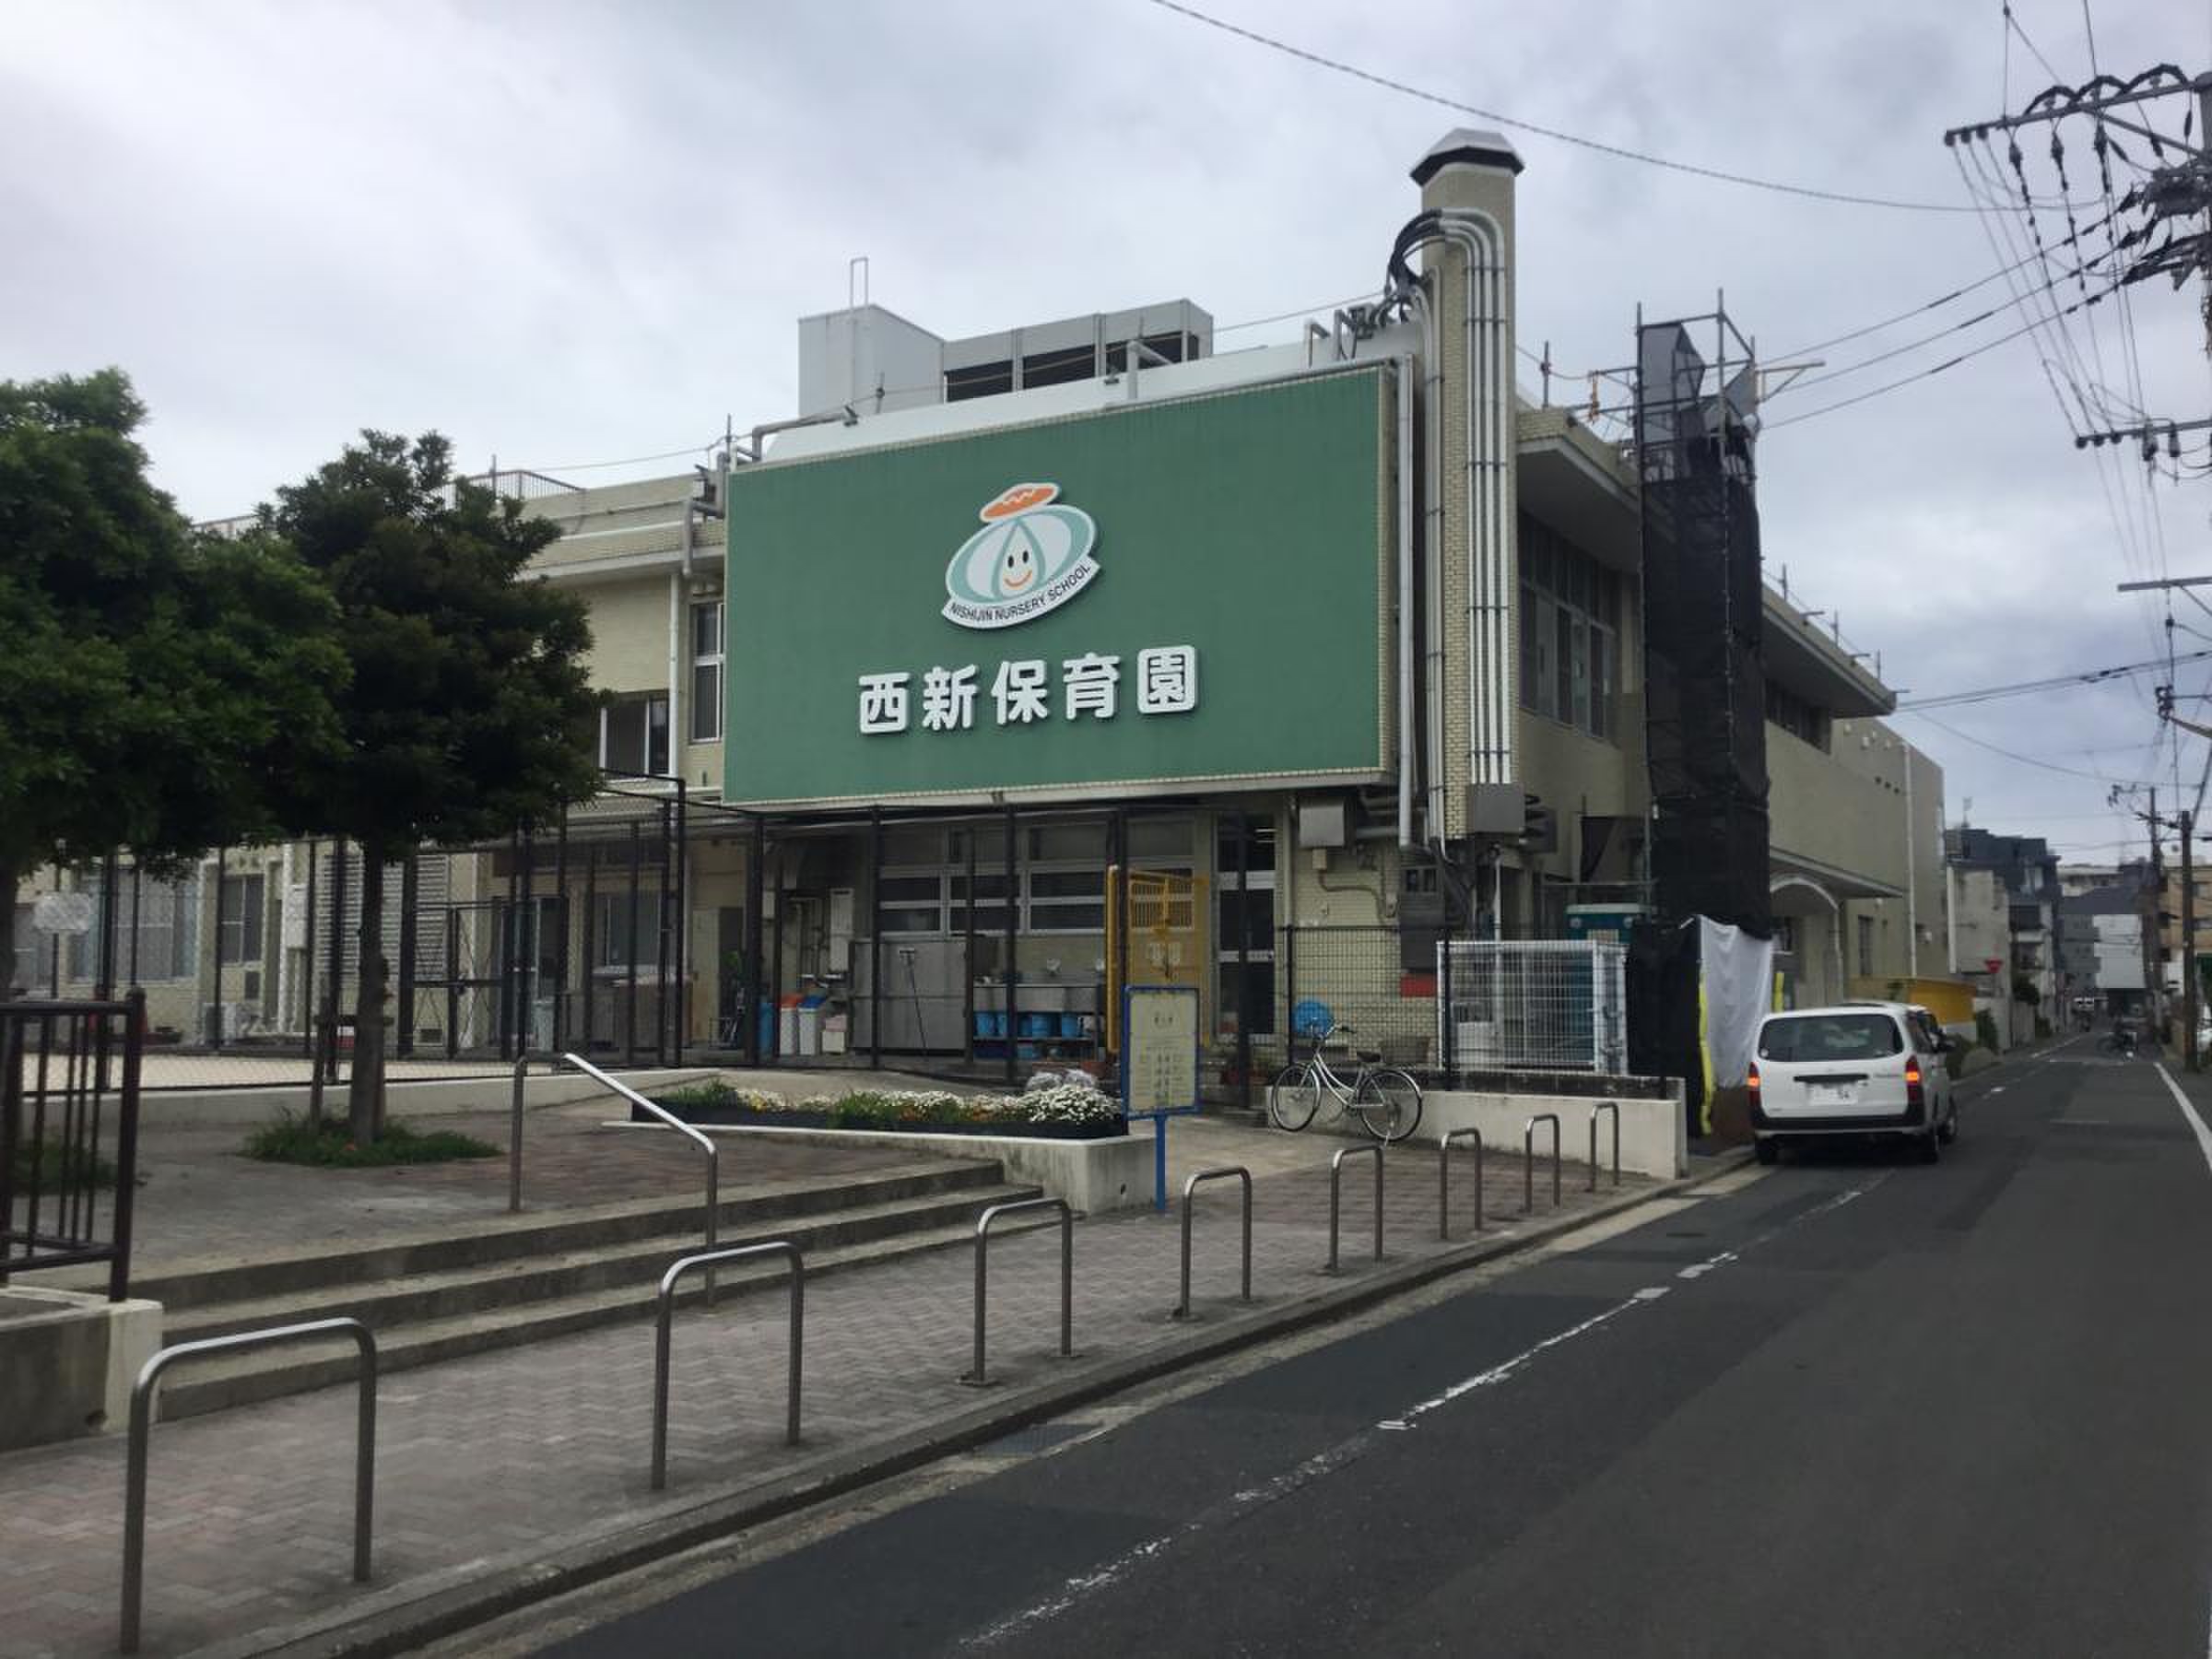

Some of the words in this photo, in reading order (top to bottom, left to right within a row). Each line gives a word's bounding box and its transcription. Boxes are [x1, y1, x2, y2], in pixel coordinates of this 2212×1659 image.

[950, 602, 994, 622] NISHIJIN
[994, 595, 1047, 620] NURSERY
[1048, 564, 1091, 602] SCHOOL
[858, 645, 1196, 734] 西新保育園
